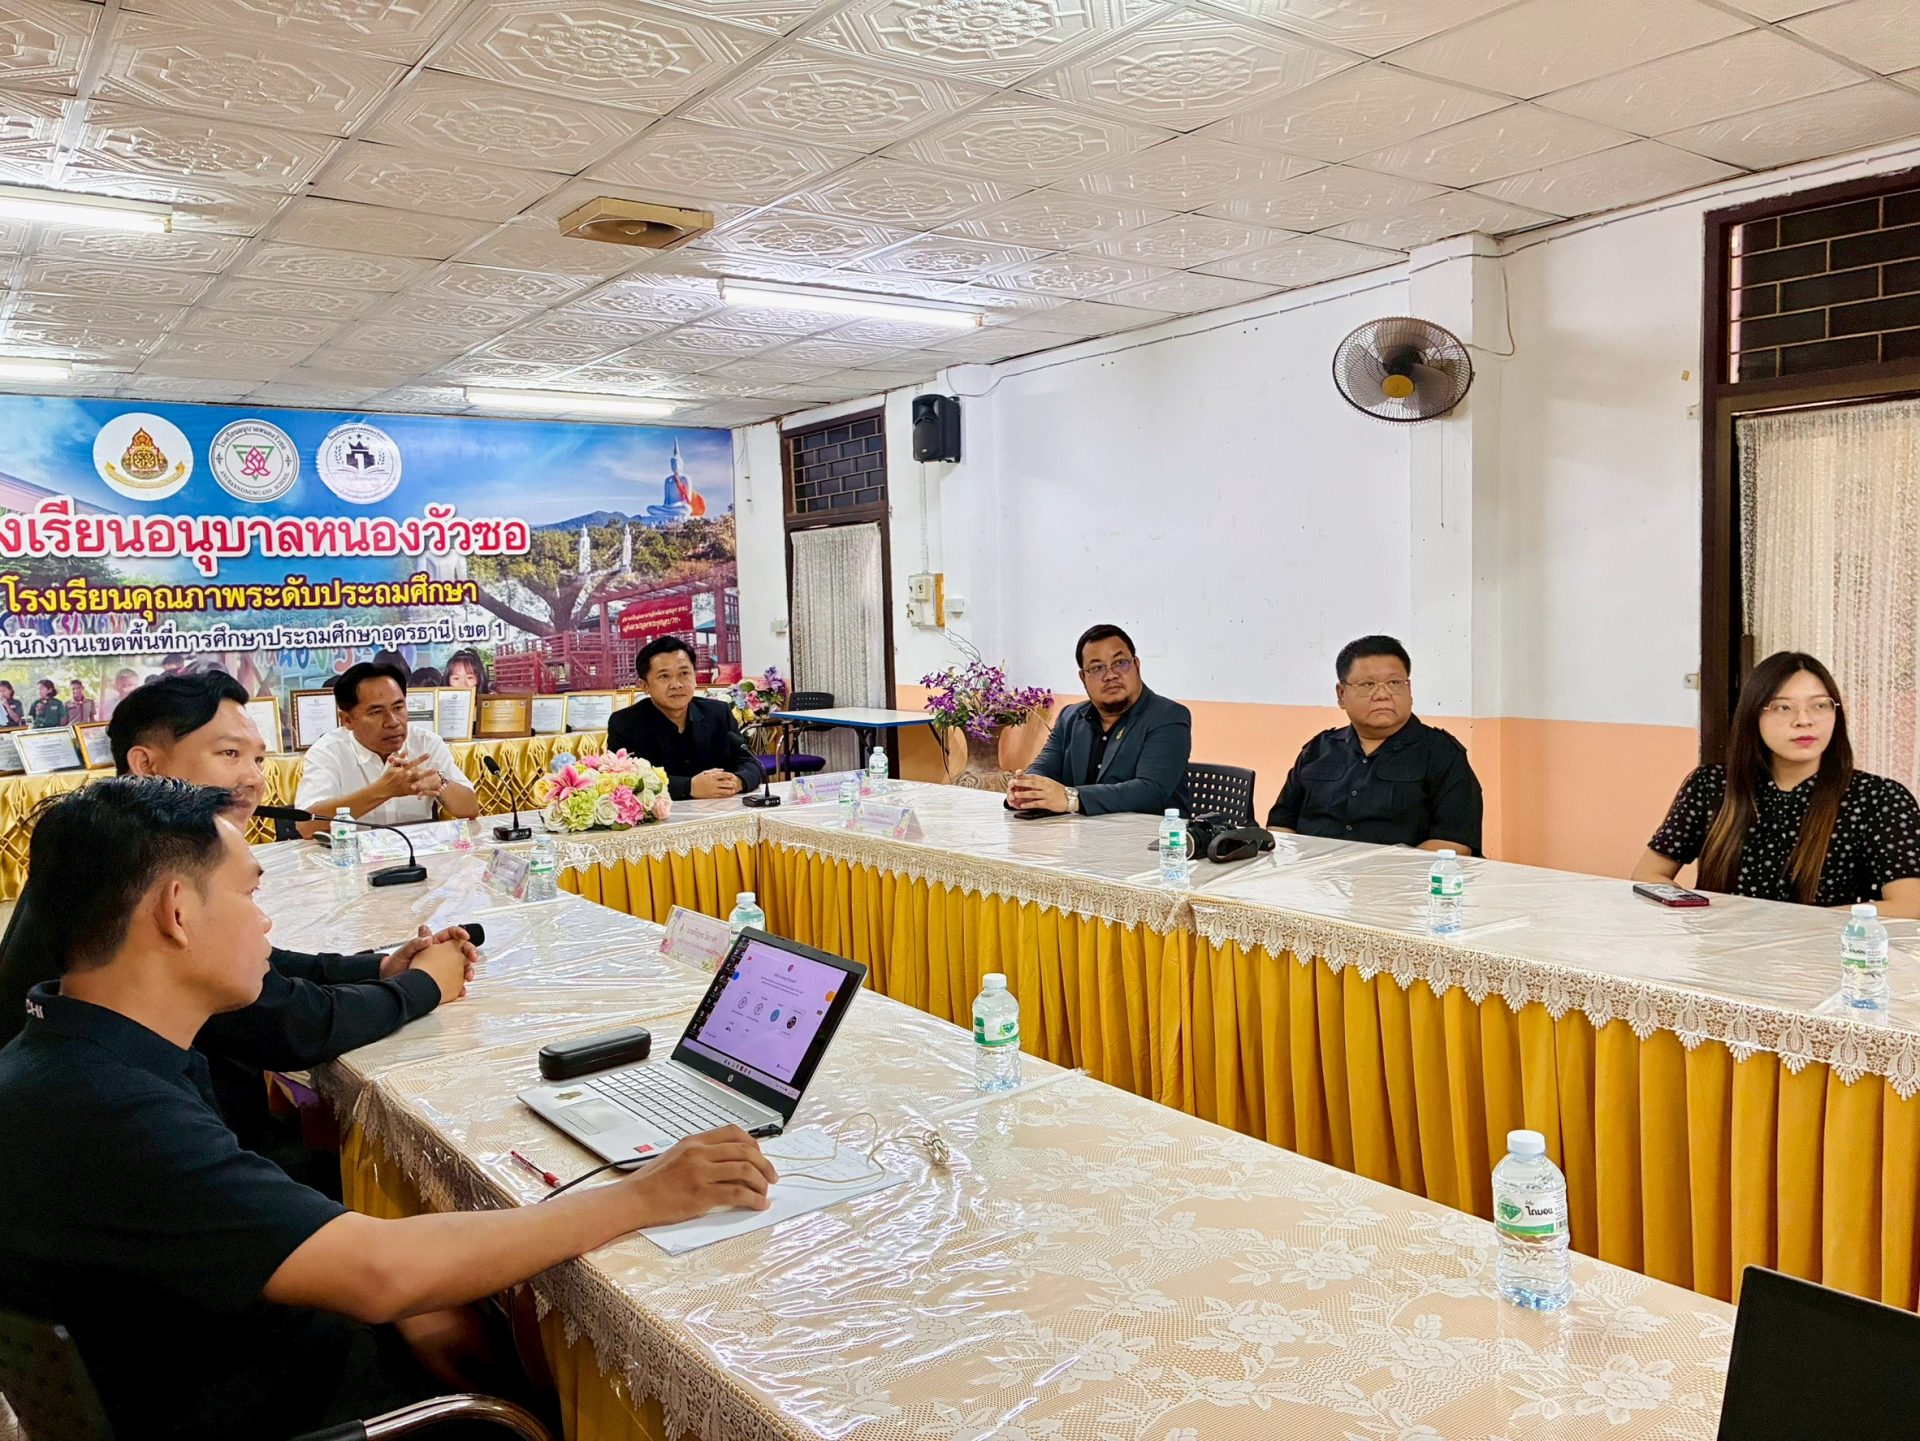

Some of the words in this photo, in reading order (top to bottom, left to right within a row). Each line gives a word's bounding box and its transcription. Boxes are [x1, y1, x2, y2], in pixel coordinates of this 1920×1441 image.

[0, 574, 477, 622] โรงเรียนคุณภาพระดับประถมศึกษา
[459, 622, 486, 638] เขต
[495, 623, 503, 637] 1
